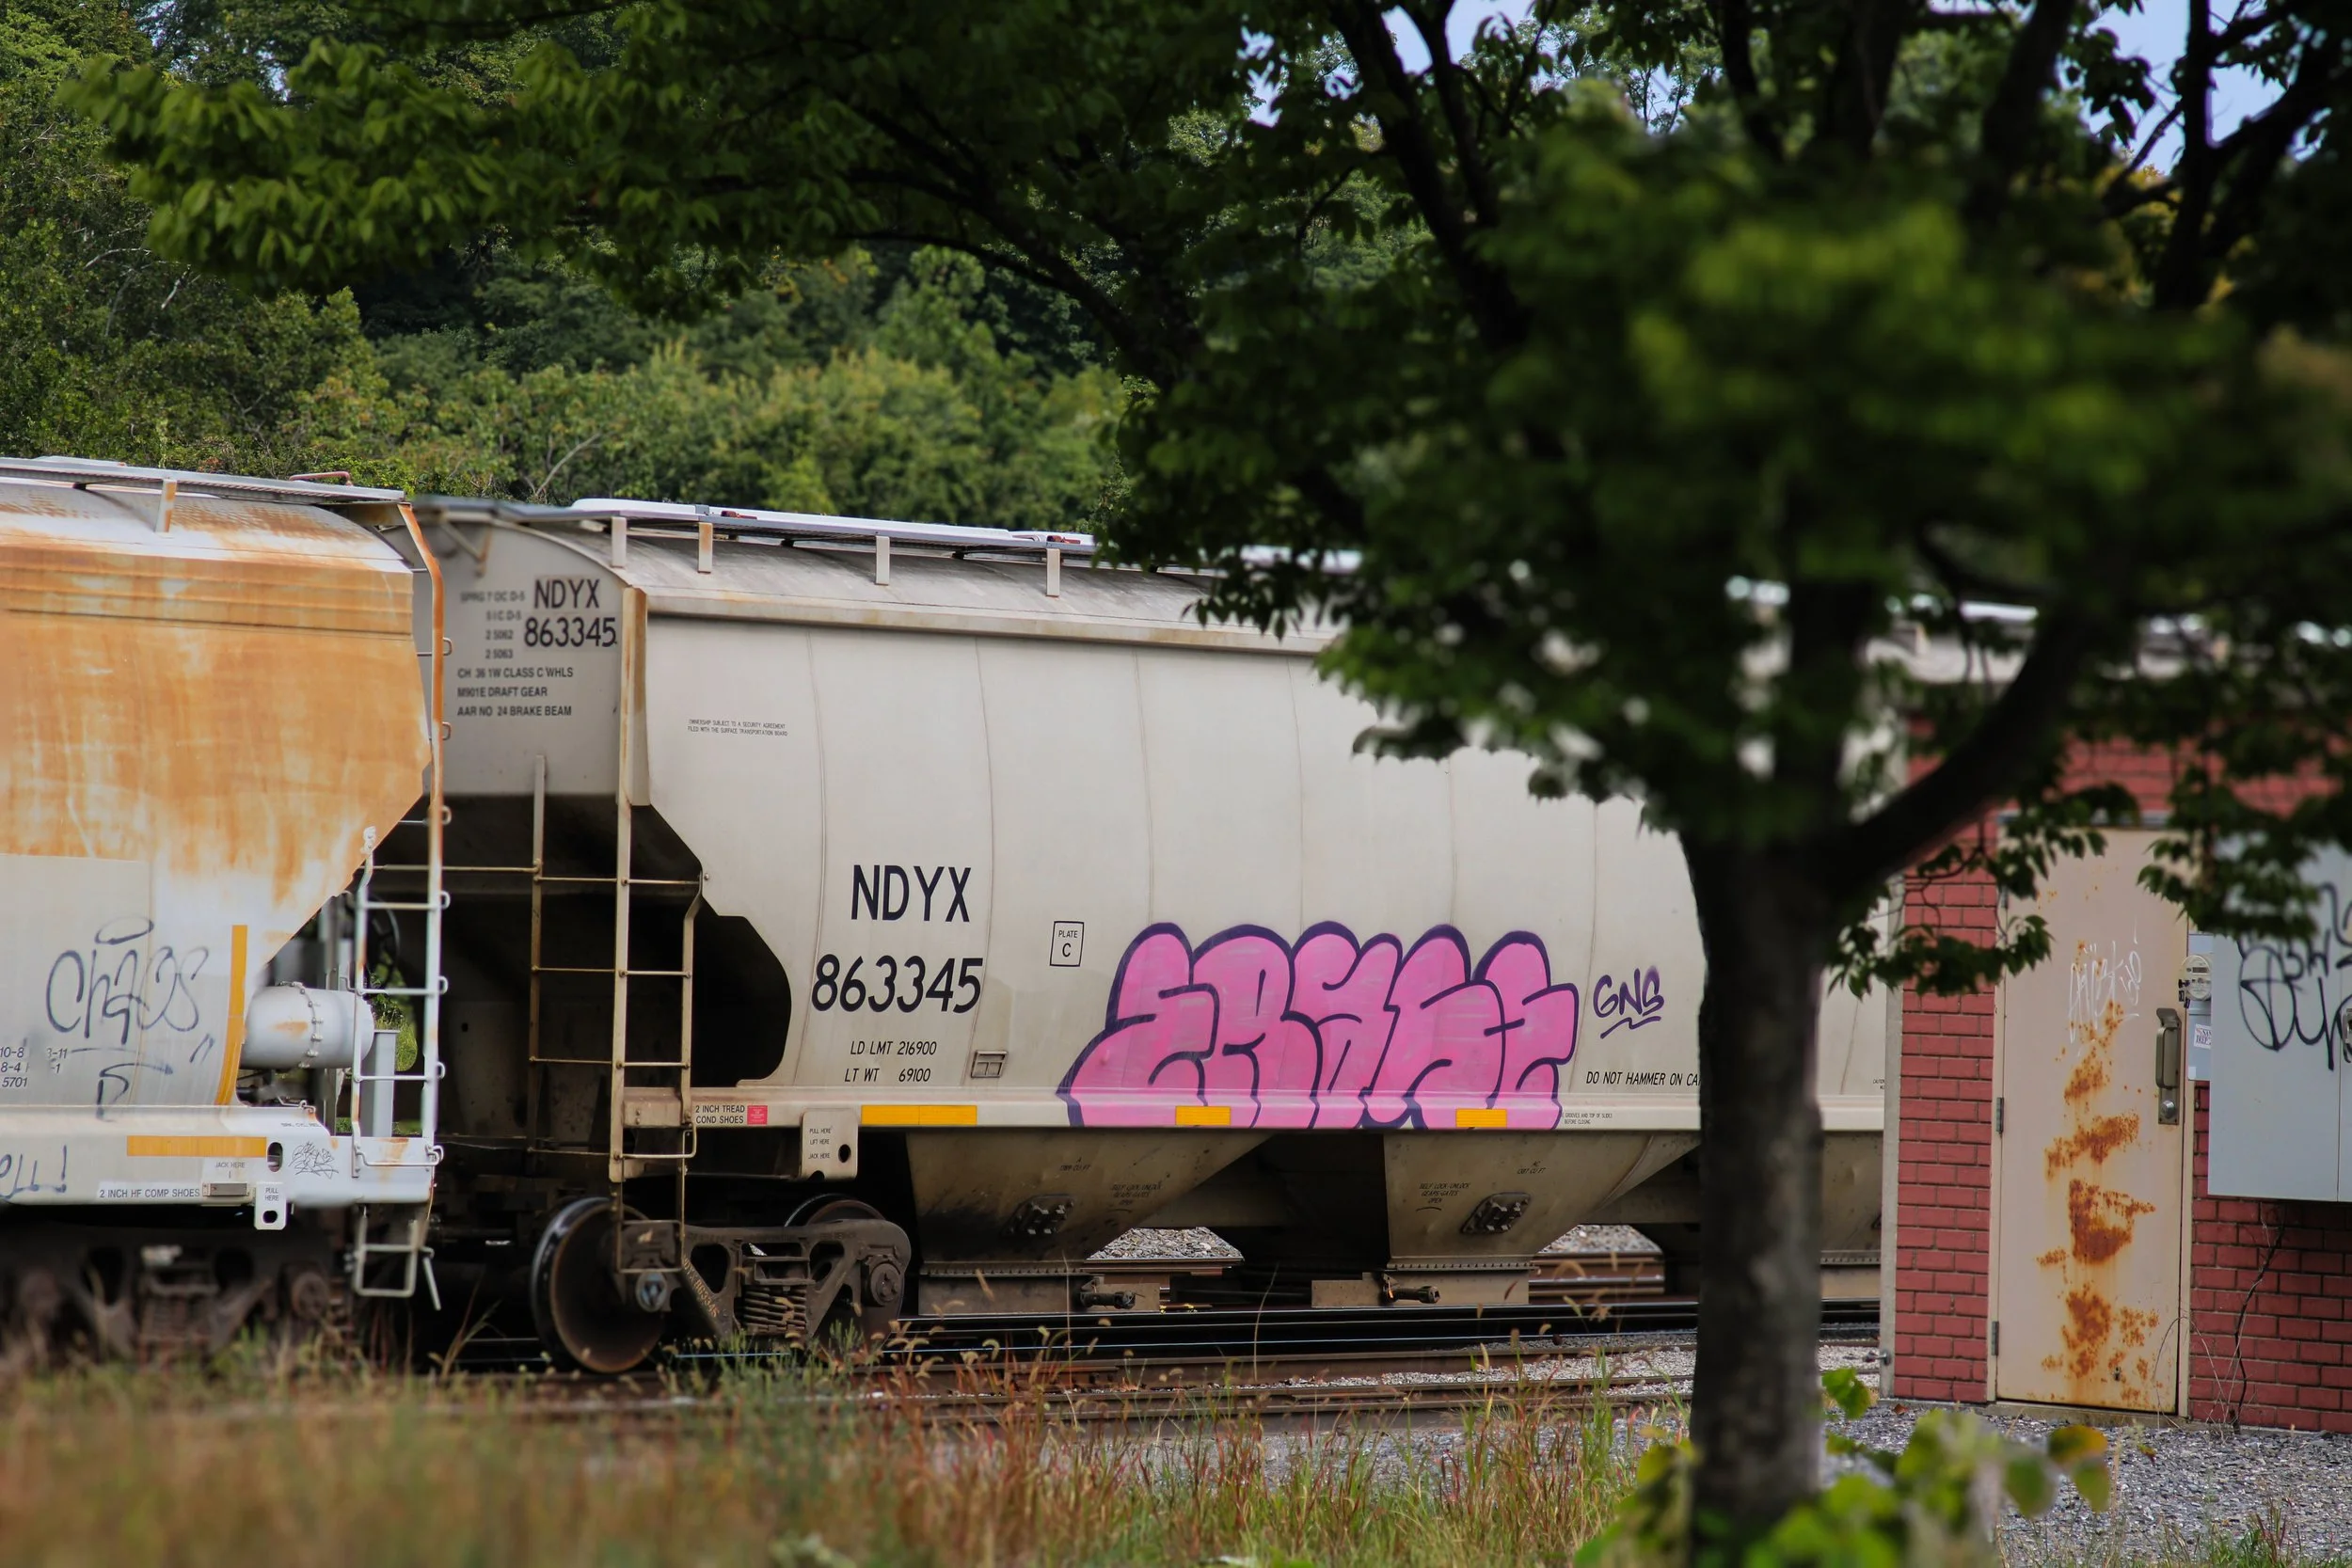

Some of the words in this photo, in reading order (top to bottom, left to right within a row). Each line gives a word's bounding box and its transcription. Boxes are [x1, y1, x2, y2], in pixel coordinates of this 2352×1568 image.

[534, 578, 599, 609] NDYX
[524, 617, 617, 647] 863345
[503, 667, 534, 677] CLASS
[537, 667, 544, 677] C
[546, 667, 574, 677] WHLS
[488, 687, 518, 697] DRAFT
[520, 687, 548, 697] GEAR
[457, 706, 477, 716] AAR
[510, 705, 543, 716] BRAKE
[545, 705, 572, 716] BEAM
[850, 864, 972, 922] NDYX
[1058, 929, 1078, 939] PLATE
[1062, 942, 1071, 958] C
[812, 954, 983, 1014] 863345
[850, 1041, 866, 1055] LD
[869, 1041, 894, 1055] LMT
[897, 1041, 937, 1055] 216900
[1, 1062, 21, 1073] 8-4
[845, 1069, 859, 1083] LT
[864, 1069, 880, 1083] WT
[898, 1069, 931, 1083] 69100
[1586, 1071, 1599, 1085] DO
[1603, 1071, 1623, 1085] NOT
[1626, 1072, 1666, 1085] HAMMER
[1670, 1073, 1683, 1085] ON
[1687, 1073, 1701, 1086] CA
[2, 1077, 28, 1088] 5701
[696, 1116, 717, 1124] COND
[719, 1116, 744, 1124] SHOES
[100, 1190, 104, 1198] 2
[107, 1189, 128, 1198] INCH
[131, 1189, 141, 1197] HF
[145, 1189, 169, 1197] COMP
[172, 1188, 200, 1197] SHOES
